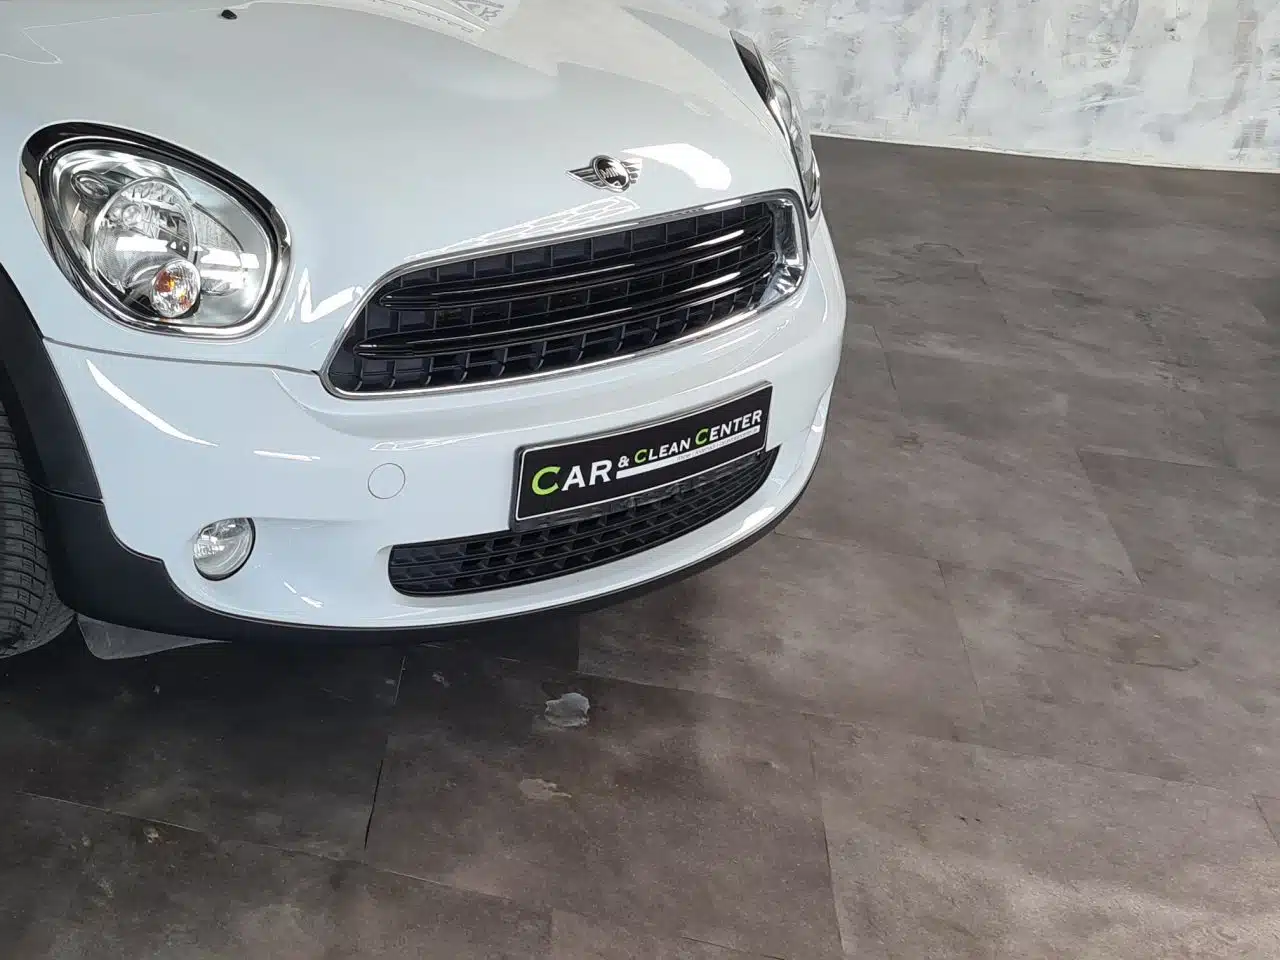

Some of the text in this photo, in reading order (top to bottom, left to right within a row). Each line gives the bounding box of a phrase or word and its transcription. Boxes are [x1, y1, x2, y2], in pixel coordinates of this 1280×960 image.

[531, 459, 613, 496] CAR
[617, 455, 630, 468] &
[634, 437, 691, 464] CLEAN
[695, 409, 762, 445] CENTER
